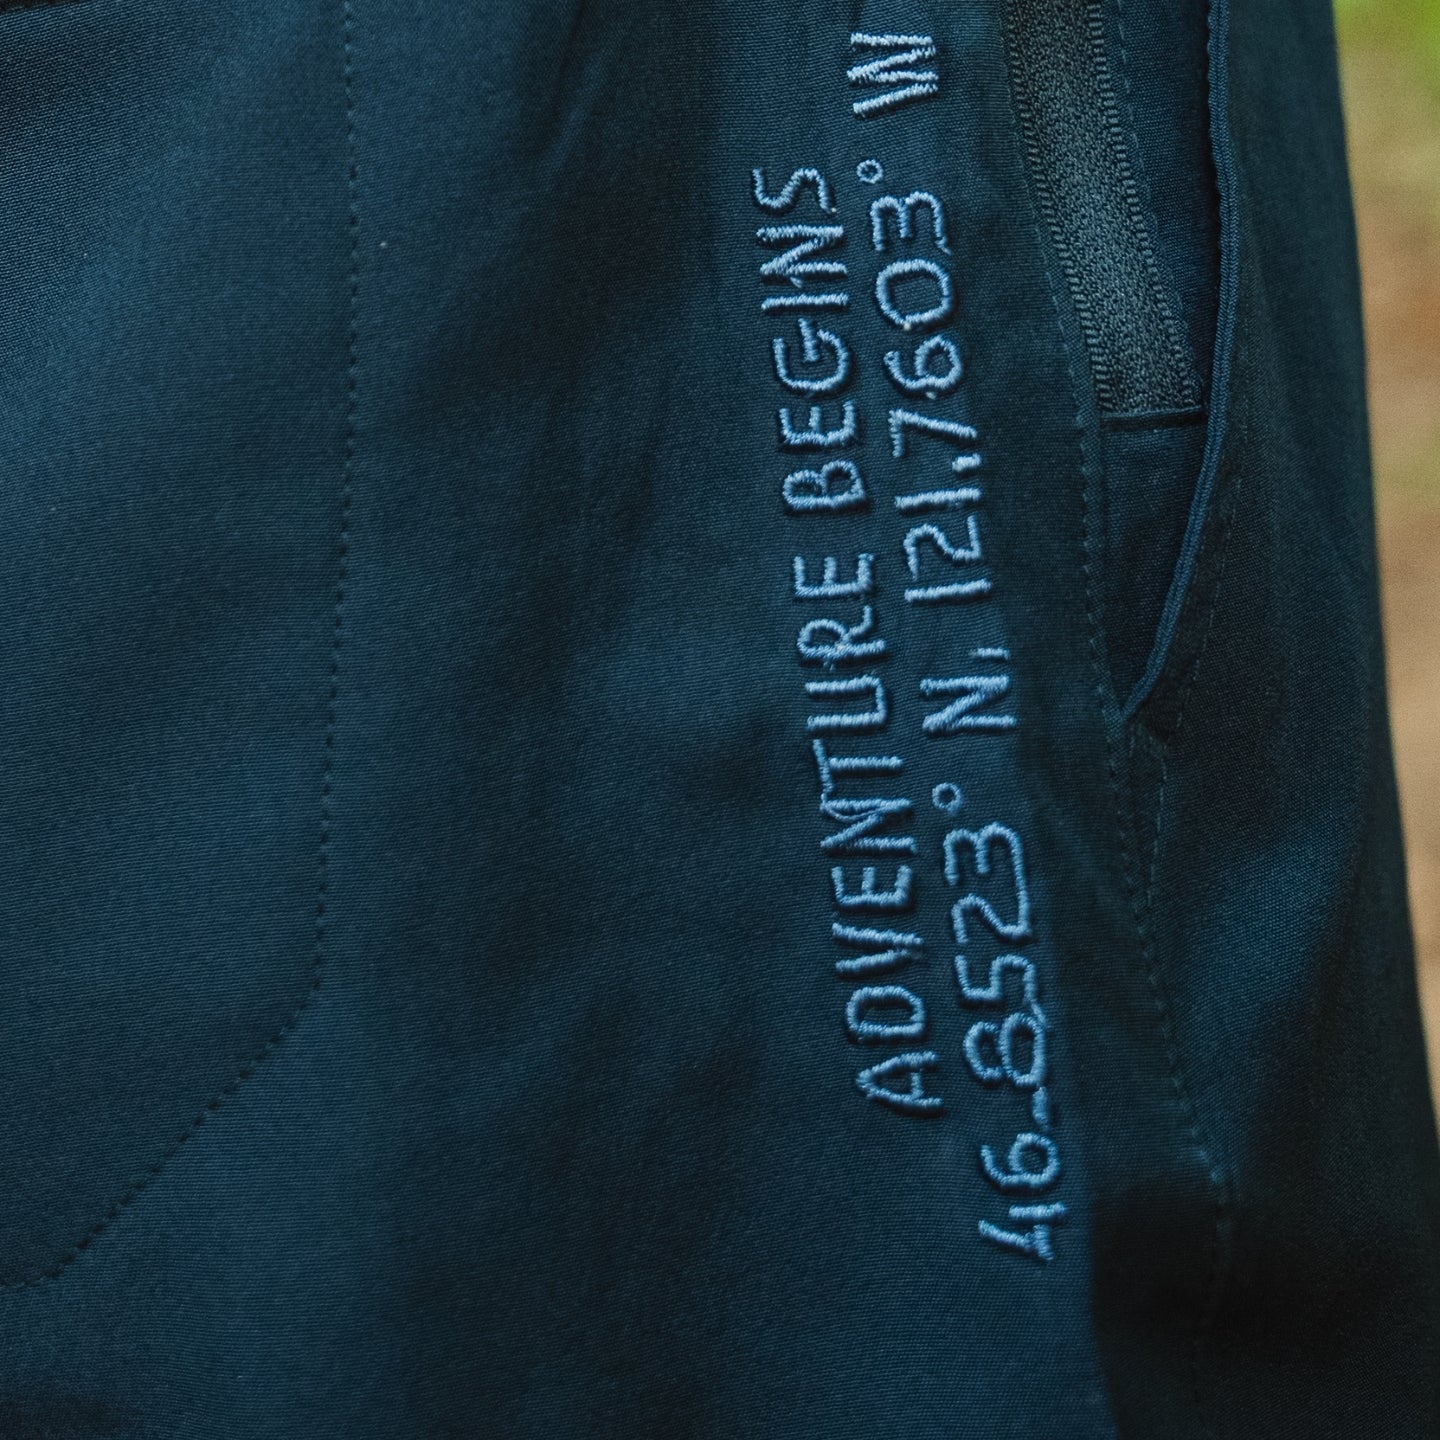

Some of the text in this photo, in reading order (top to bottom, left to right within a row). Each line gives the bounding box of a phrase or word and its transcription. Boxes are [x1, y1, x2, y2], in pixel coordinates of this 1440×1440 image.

[847, 32, 940, 117] W
[753, 167, 944, 1110] ADVENTURE BEGINS
[920, 647, 1017, 733] N,
